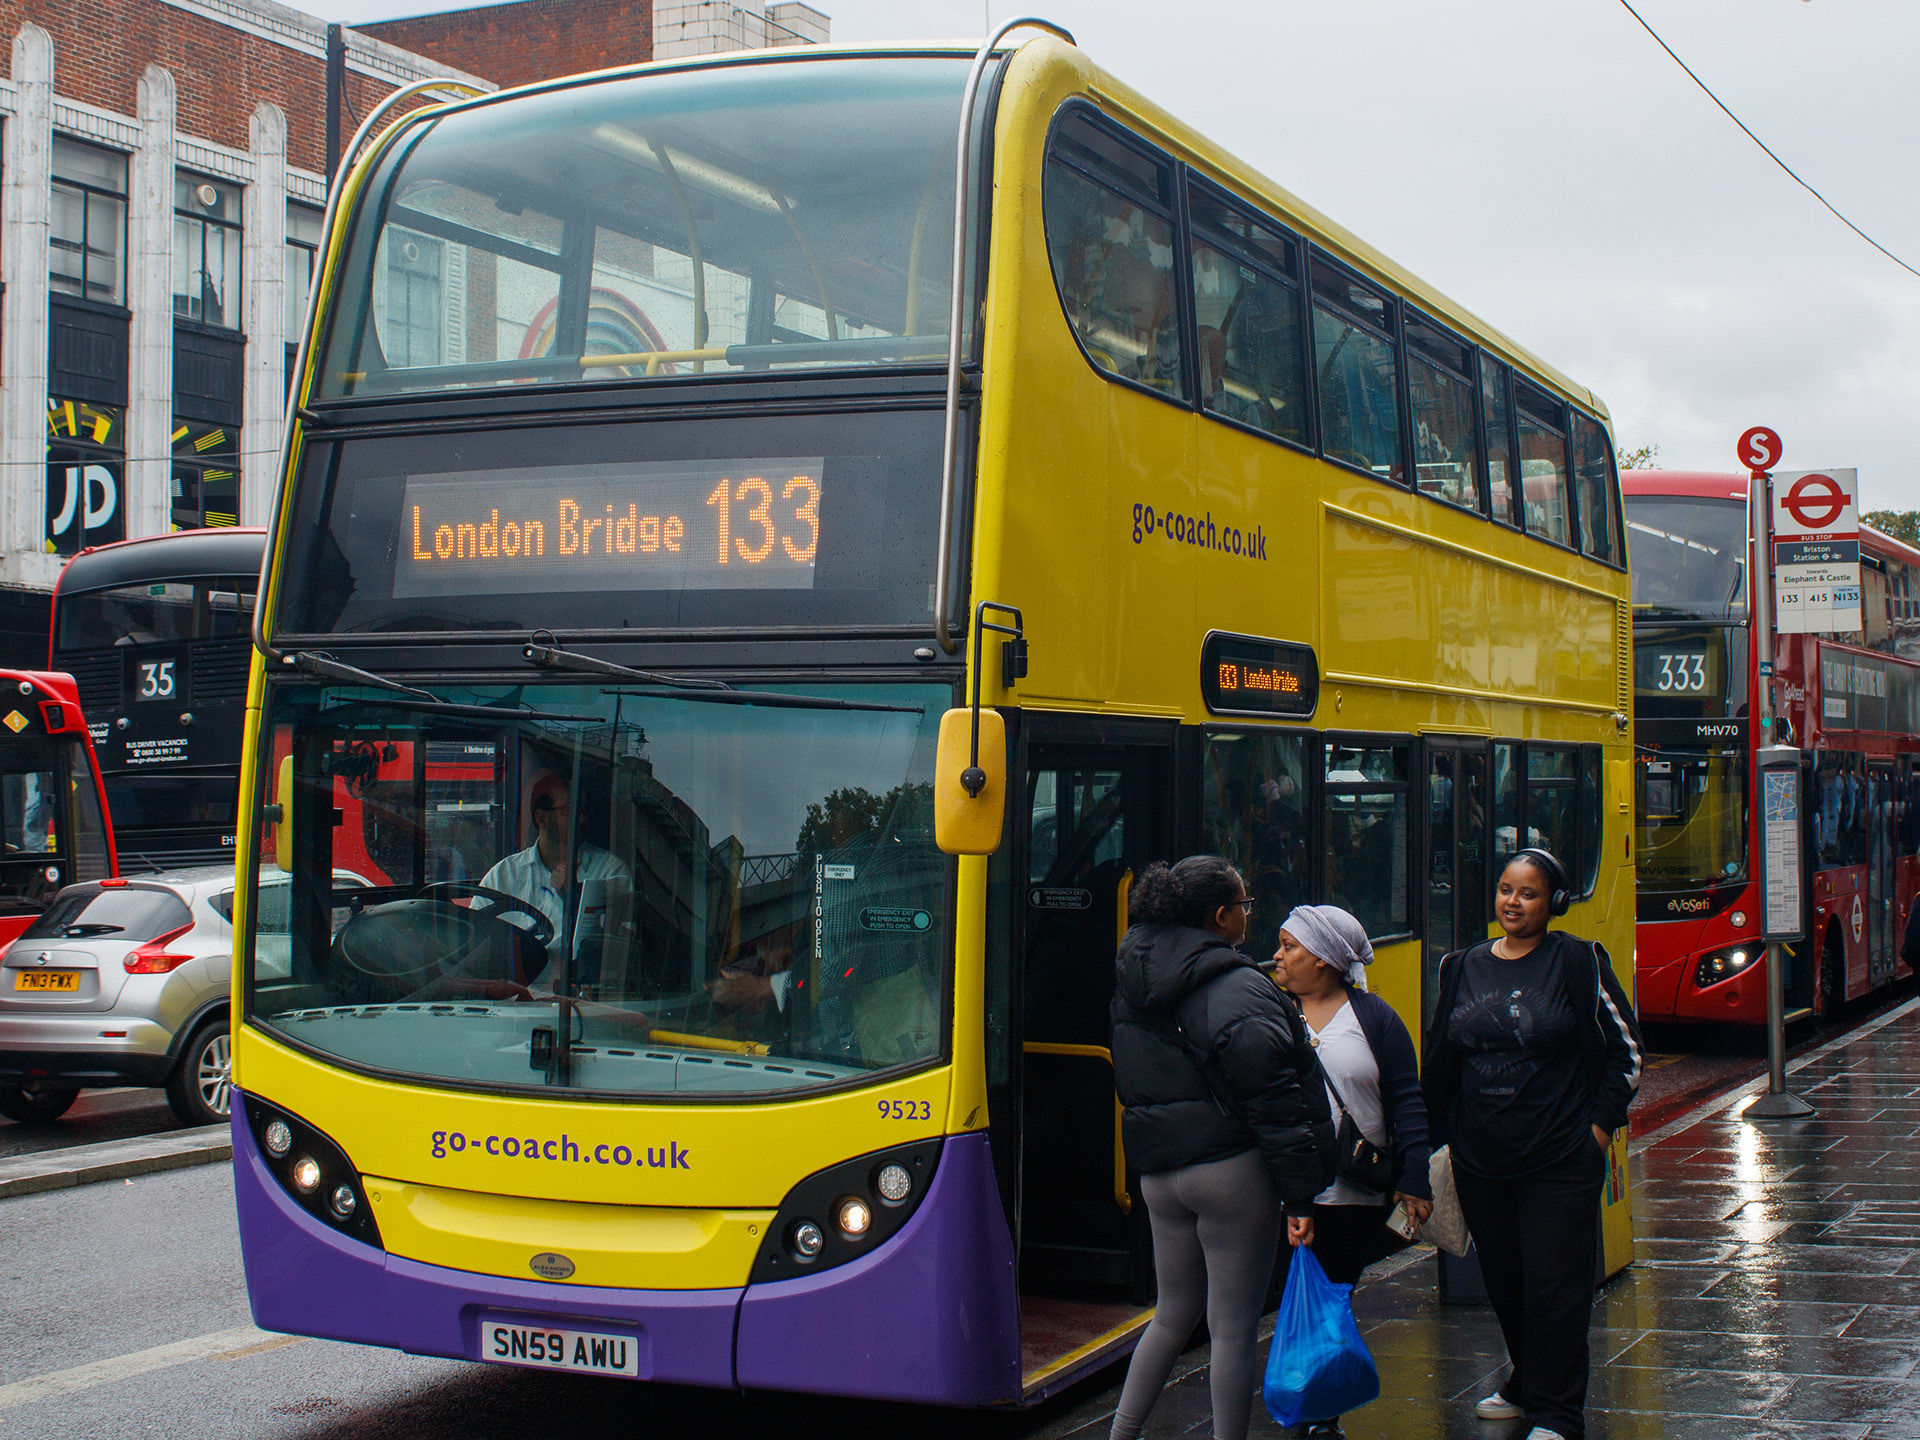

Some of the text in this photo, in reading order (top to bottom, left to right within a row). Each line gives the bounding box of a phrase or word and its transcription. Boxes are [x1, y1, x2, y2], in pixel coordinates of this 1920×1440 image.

[1749, 432, 1771, 466] S
[52, 464, 117, 536] JD
[413, 475, 820, 564] London Bridge 133
[1132, 502, 1267, 561] go-coach.co.uk
[1793, 554, 1820, 562] Station
[1784, 574, 1851, 584] Elephant & Castle
[1781, 592, 1859, 603] 133 415 N133
[141, 661, 175, 697] 35
[1219, 664, 1298, 692] 133 London Bridge
[1658, 654, 1706, 691] 333
[1696, 725, 1739, 736] MHV70
[126, 738, 188, 749] BUS DRIVER VACANCIES
[815, 853, 823, 894] PUSH
[815, 896, 823, 917] TO
[867, 908, 901, 916] EMERGENCY
[1667, 897, 1710, 913] eVoSeti
[22, 973, 74, 988] FN13 FWX
[877, 1099, 932, 1121] 9523
[430, 1129, 692, 1170] go-coach.co.uk
[533, 1264, 570, 1272] ALEXANDER
[493, 1327, 627, 1370] SN59 AWU
